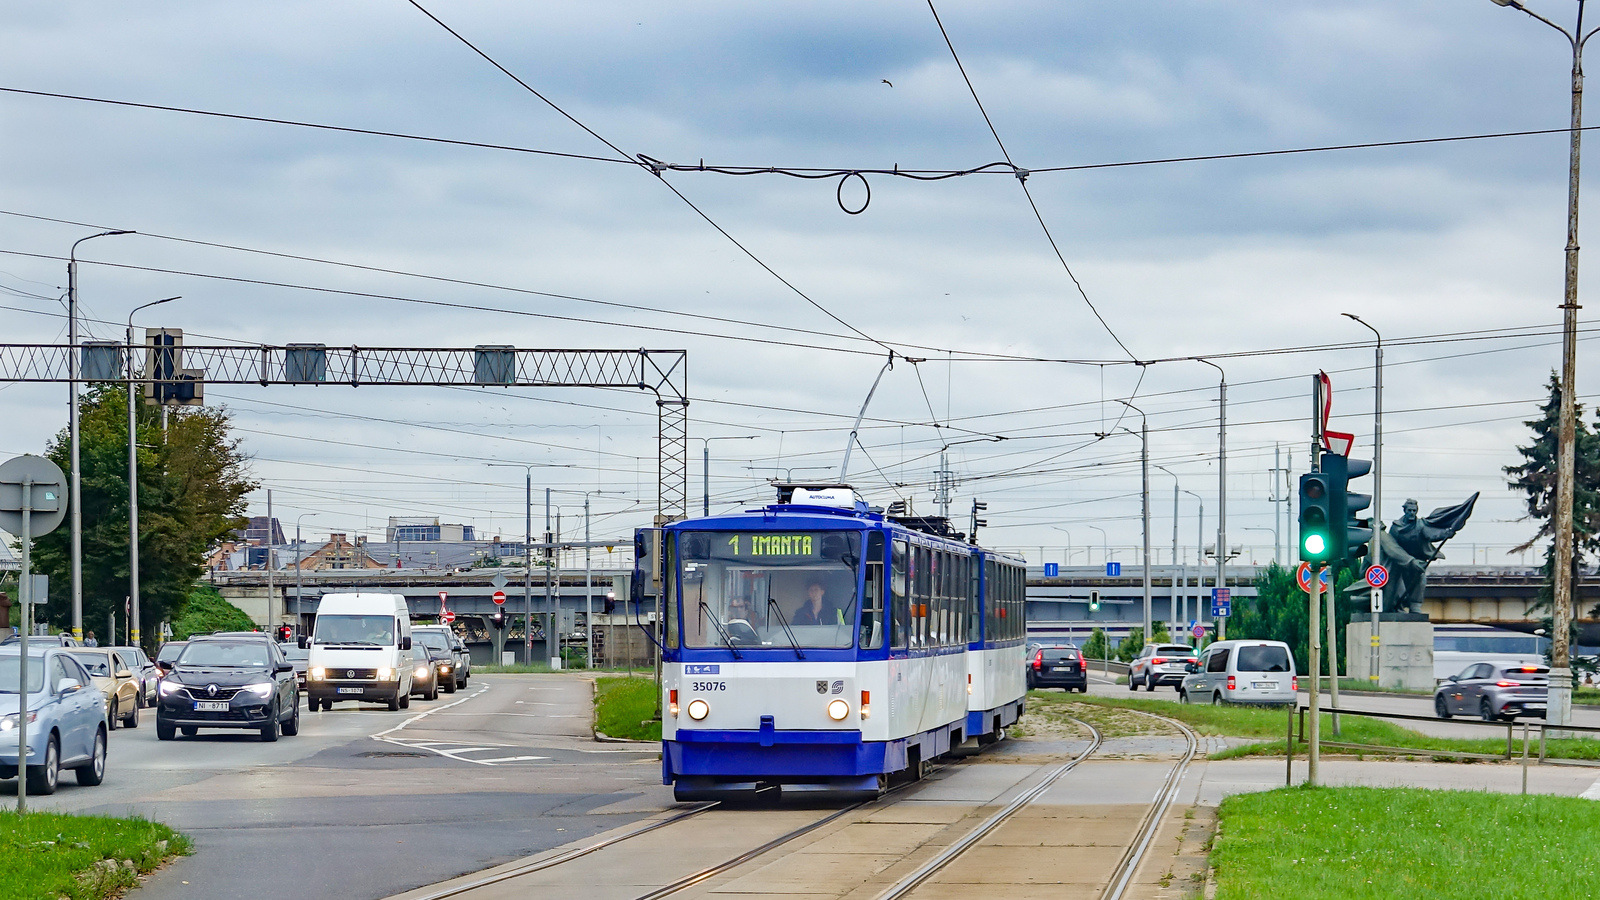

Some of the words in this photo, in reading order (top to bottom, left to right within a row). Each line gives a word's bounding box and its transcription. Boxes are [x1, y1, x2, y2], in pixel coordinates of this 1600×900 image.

[728, 534, 739, 555] 1
[751, 535, 812, 555] IMANTA
[692, 681, 727, 692] 35076
